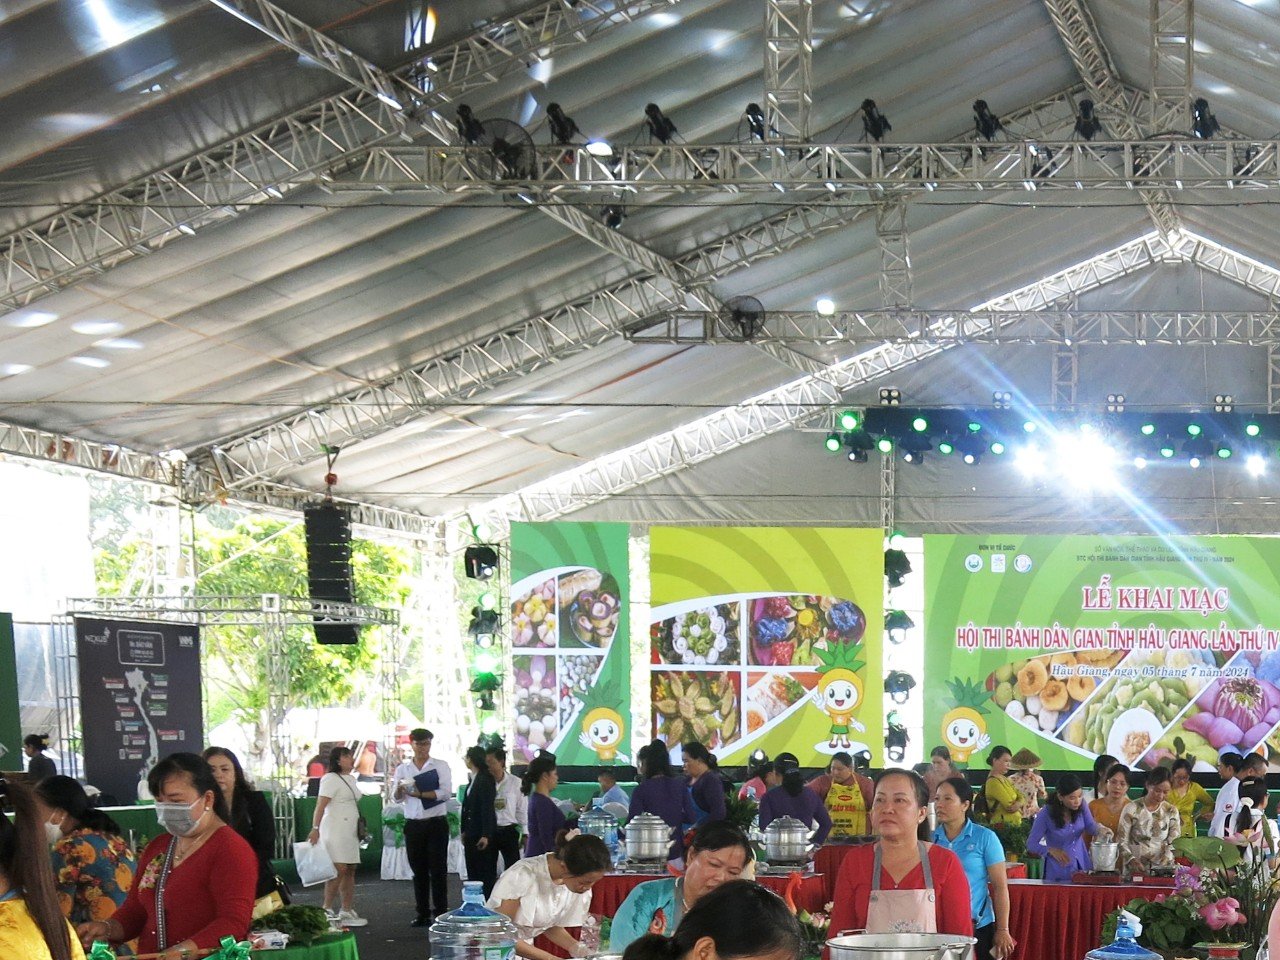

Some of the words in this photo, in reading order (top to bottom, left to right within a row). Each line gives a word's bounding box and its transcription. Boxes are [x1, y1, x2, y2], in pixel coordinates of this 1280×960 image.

[1083, 575, 1111, 610] LỄ
[1118, 587, 1174, 610] KHAI
[1180, 588, 1229, 616] MẠC
[957, 622, 979, 653] HỘI
[983, 628, 1002, 649] THI
[1006, 621, 1038, 649] BÁNH
[1044, 622, 1069, 649] DÂN
[1074, 628, 1103, 649] GIAN
[1107, 622, 1135, 650] TỈNH
[1139, 622, 1164, 654] HẬU
[1169, 630, 1208, 651] GIANG
[1211, 621, 1236, 651] LẦN
[1239, 625, 1263, 651] THỨ
[1267, 631, 1280, 650] IV
[1052, 665, 1074, 679] Hậu
[1077, 665, 1112, 678] Giang,
[1114, 665, 1139, 678] ngày
[1142, 666, 1154, 677] 05
[1191, 667, 1197, 676] 7
[1225, 667, 1250, 677] 2024
